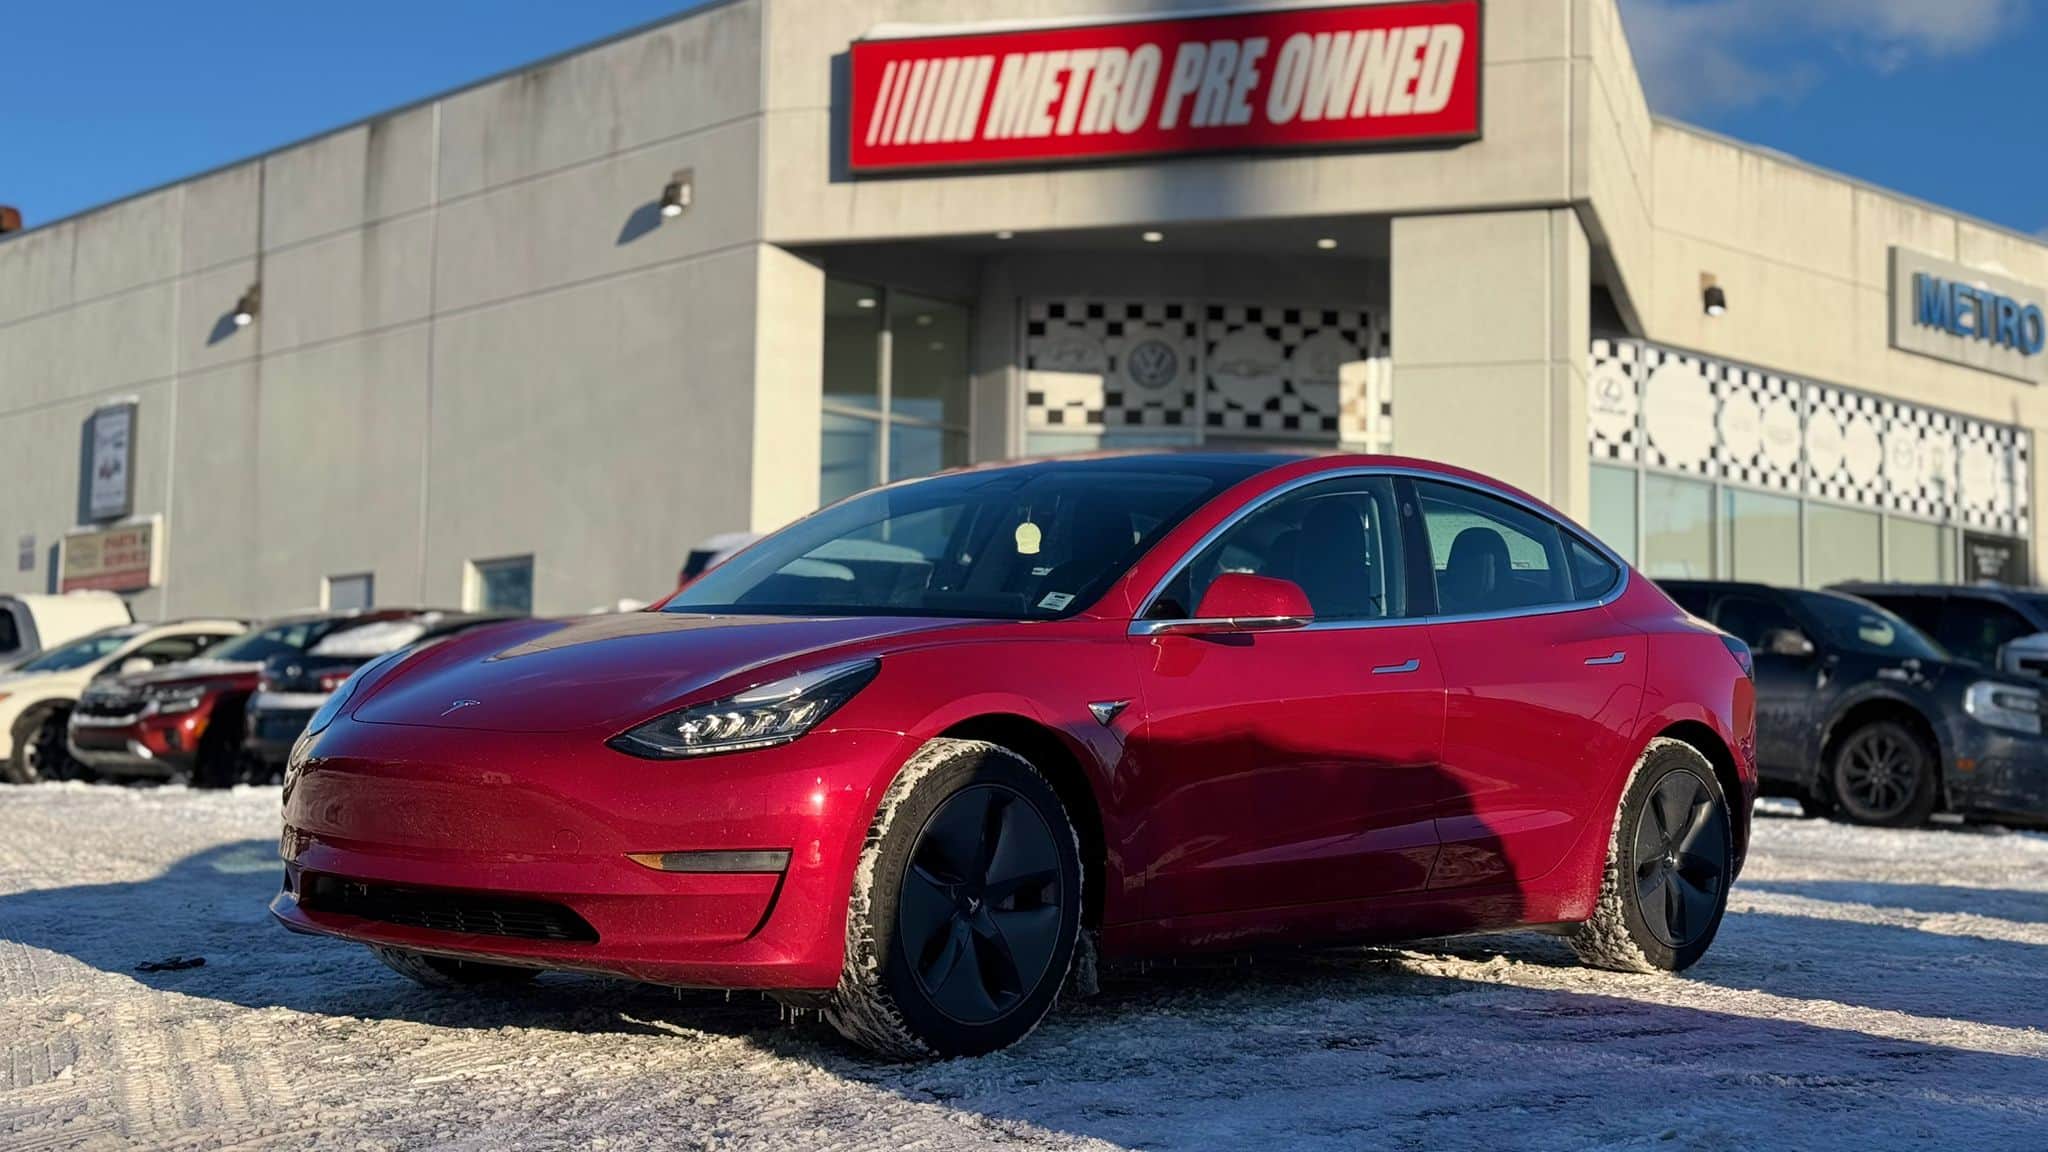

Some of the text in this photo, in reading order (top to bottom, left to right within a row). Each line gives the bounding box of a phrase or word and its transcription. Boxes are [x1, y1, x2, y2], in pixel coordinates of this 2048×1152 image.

[983, 23, 1465, 140] METRO PRE OWNED
[1914, 271, 2045, 357] METRO
